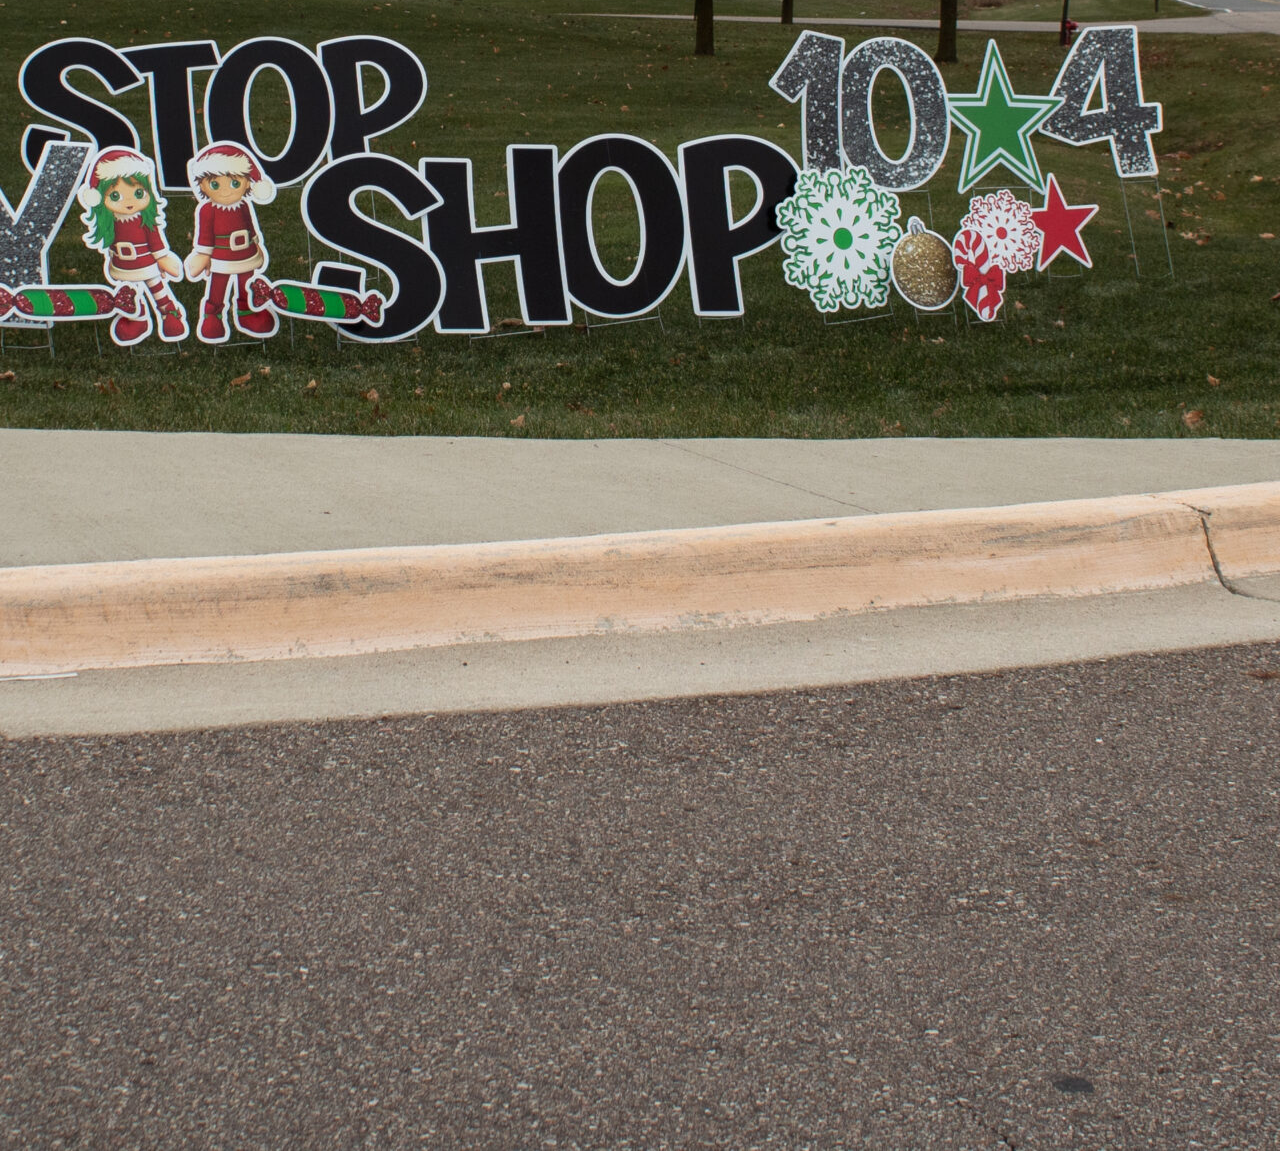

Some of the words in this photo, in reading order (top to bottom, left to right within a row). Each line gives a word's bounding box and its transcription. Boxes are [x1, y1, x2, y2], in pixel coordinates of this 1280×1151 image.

[20, 35, 427, 191] STOP
[769, 29, 950, 191] 10
[1038, 25, 1162, 177] 4
[301, 133, 799, 342] SHOP
